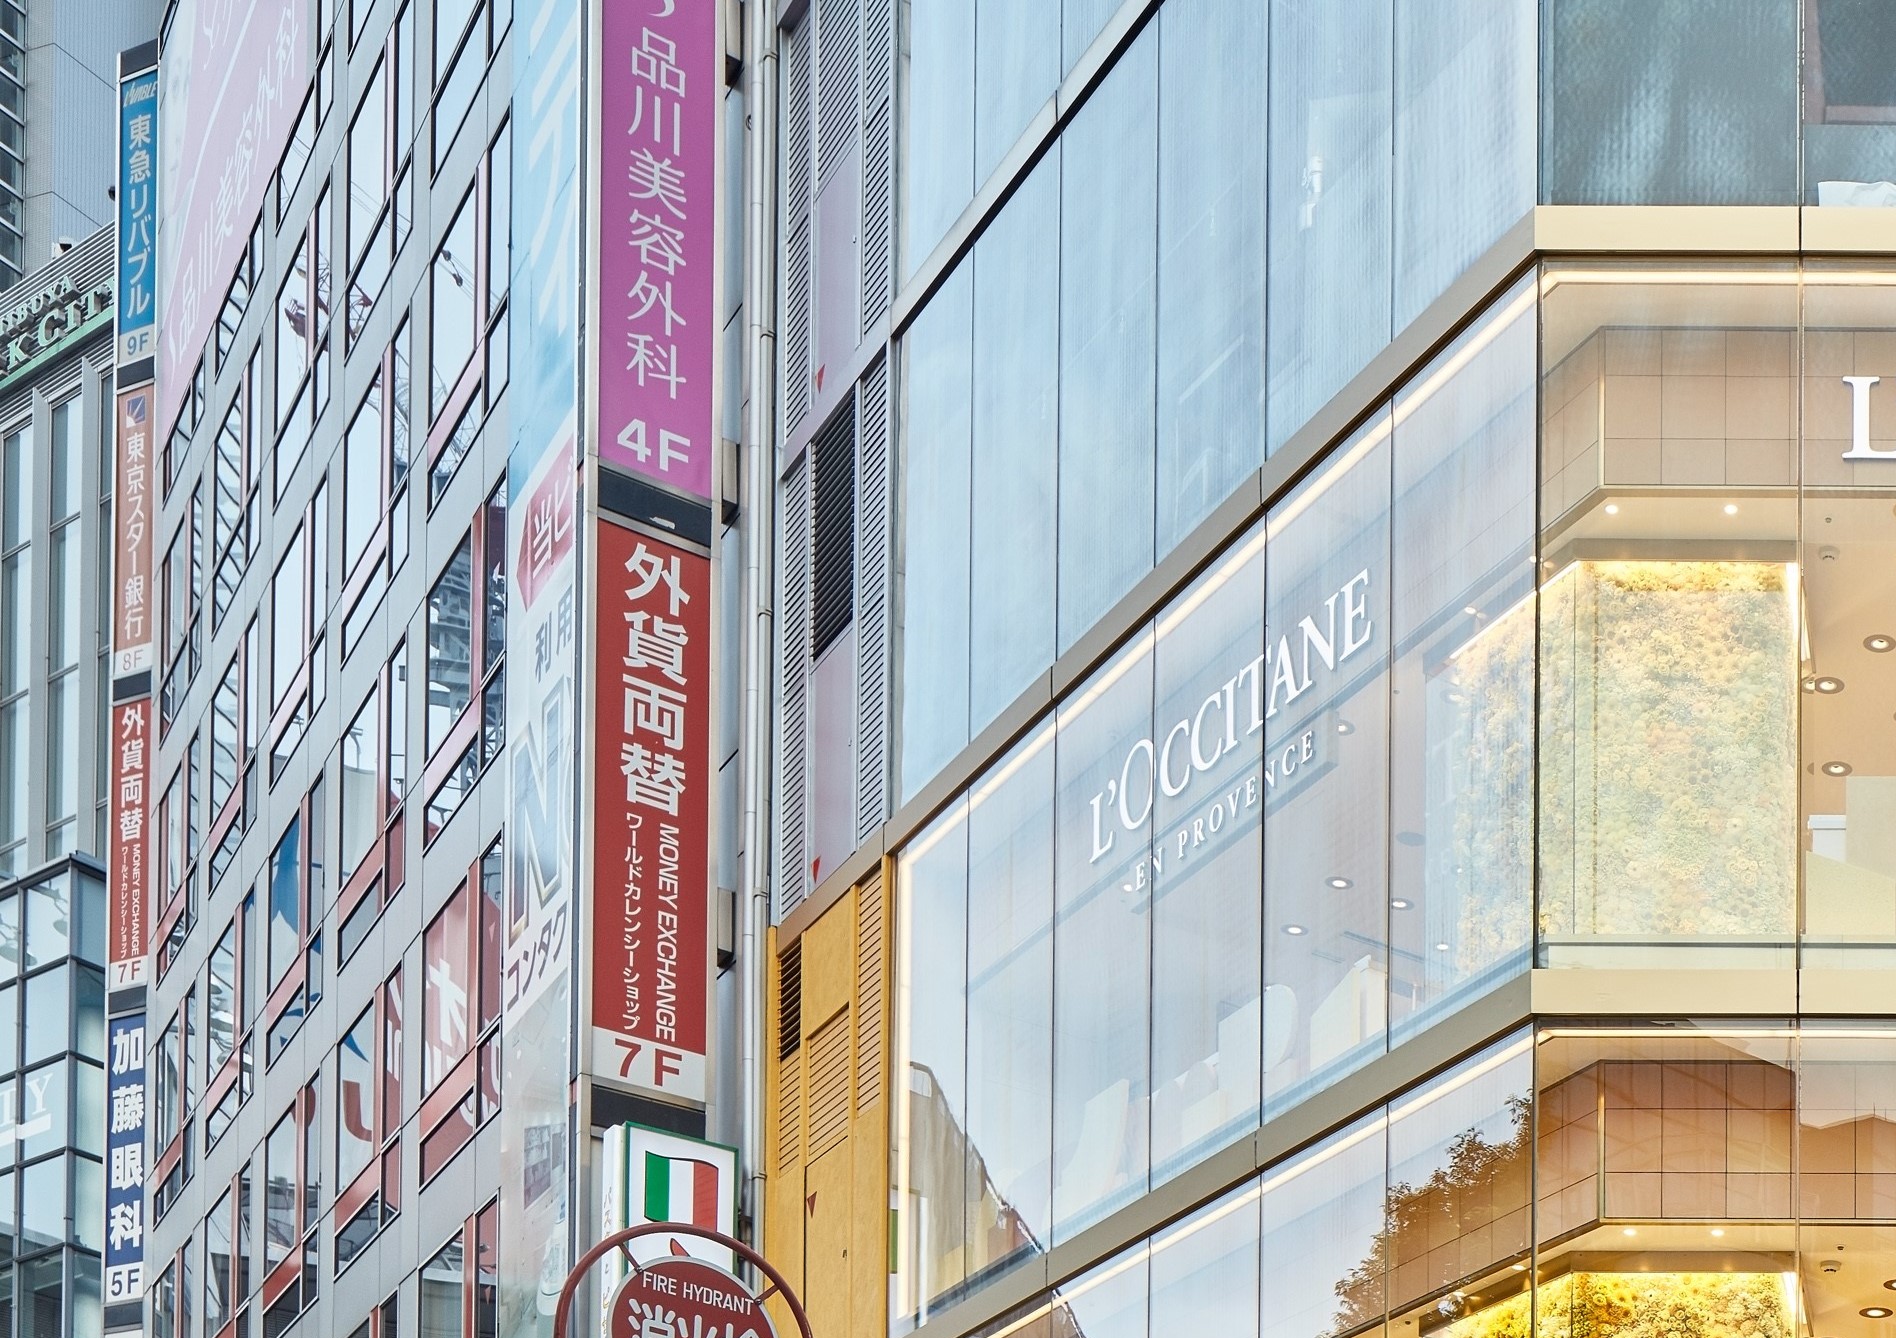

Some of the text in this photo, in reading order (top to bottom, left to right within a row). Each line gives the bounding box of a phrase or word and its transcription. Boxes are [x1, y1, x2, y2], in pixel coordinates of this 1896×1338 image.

[127, 114, 152, 319] 東急リバブル
[627, 26, 687, 400] 品川美容外科
[127, 335, 149, 356] 9F
[617, 418, 691, 472] 4F
[125, 432, 145, 640] 東京スター銀行
[123, 650, 143, 672] 8F
[619, 542, 691, 817] 外貨両替
[1088, 568, 1373, 864] L'OCCITANE
[119, 704, 145, 842] 外貨両替
[1135, 730, 1316, 893] EN PROVENCE
[118, 960, 142, 983] 7F
[131, 844, 141, 956] MONEY EXCHANGE
[622, 813, 643, 1031] ワールドカレンシーショップ
[655, 822, 680, 1043] MONEY EXCHANGE
[613, 1037, 682, 1087] 7F
[110, 1026, 144, 1250] 加藤眼科
[110, 1266, 141, 1298] 5F
[642, 1271, 754, 1316] FIRE HYDRANT
